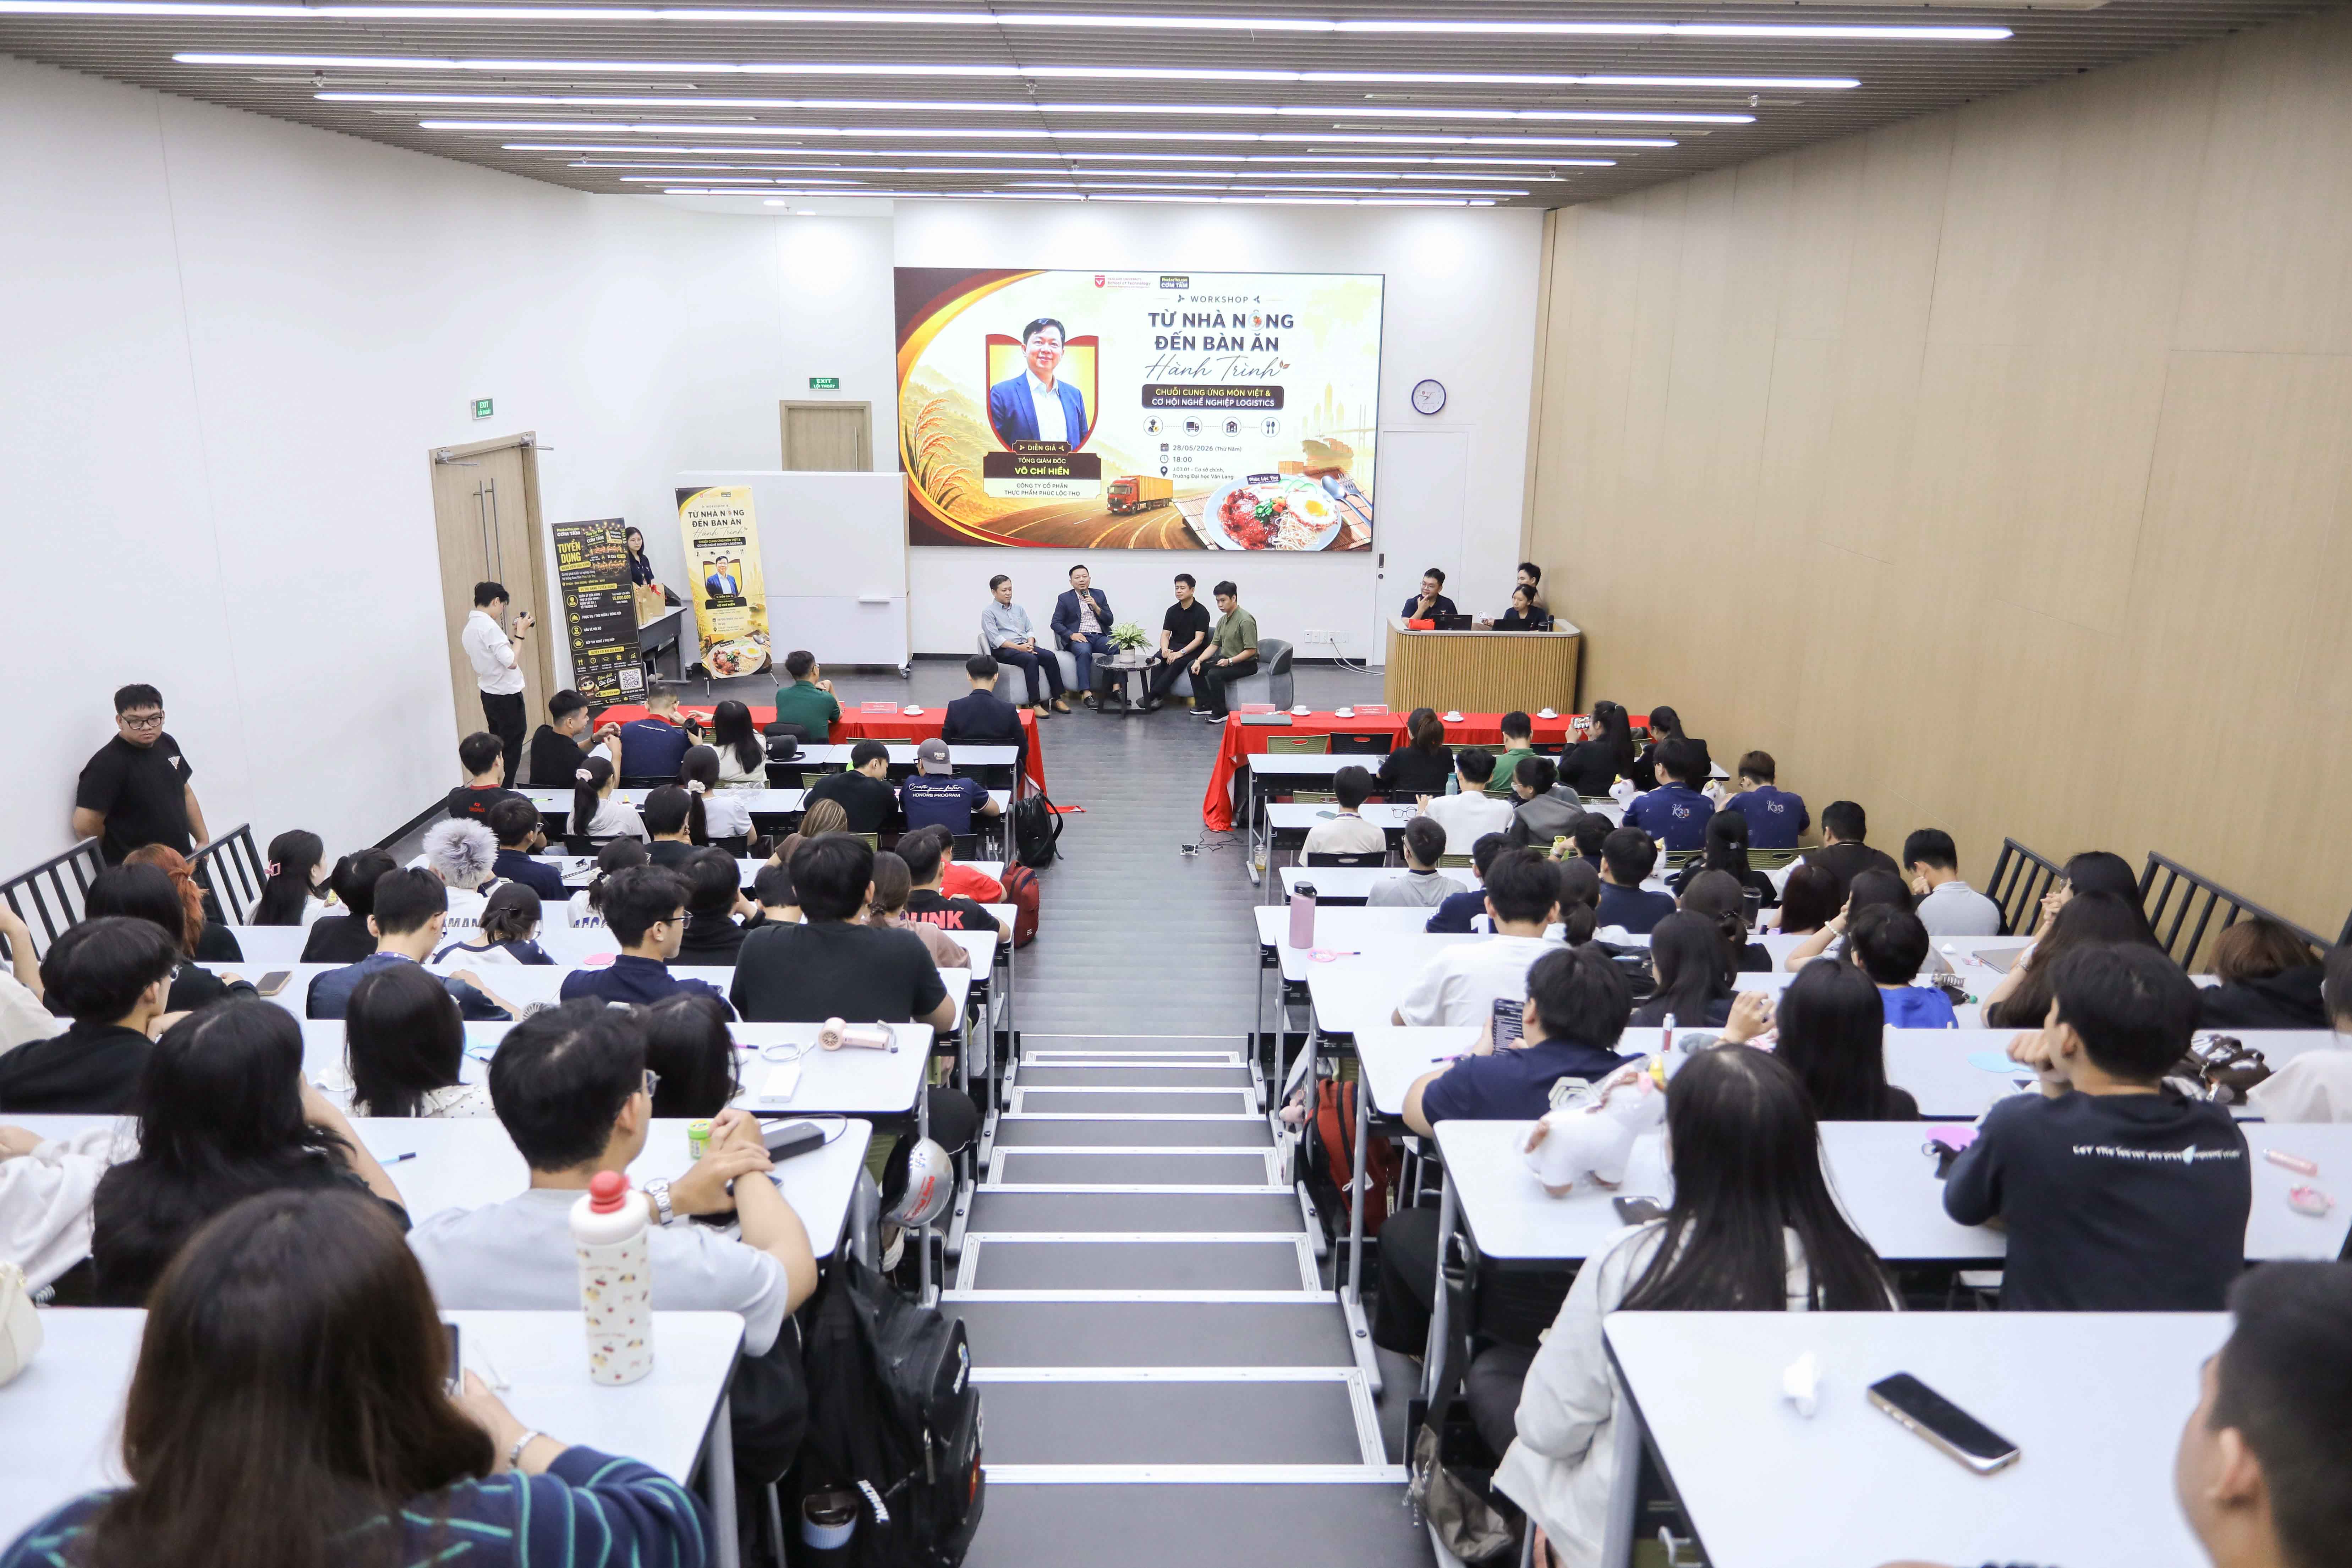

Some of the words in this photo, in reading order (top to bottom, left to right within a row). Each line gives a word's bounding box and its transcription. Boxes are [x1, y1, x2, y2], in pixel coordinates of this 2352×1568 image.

[1148, 309, 1177, 328] TỪ
[1183, 309, 1226, 328] NHÀ
[1155, 331, 1195, 351] ĐẾN
[1203, 333, 1244, 351] BÀN
[1250, 333, 1278, 352] ĂN
[1145, 353, 1212, 381] Hành
[1216, 355, 1280, 381] Trình
[1156, 386, 1180, 396] CHUỖI
[1207, 388, 1224, 396] ỨNG
[1226, 388, 1246, 396] MÓN
[1247, 389, 1263, 398] VIỆT
[1166, 398, 1179, 407] HỘI
[1205, 398, 1234, 408] NGHIỆP
[1014, 466, 1027, 475] VÕ
[688, 510, 698, 518] TỪ
[701, 509, 718, 517] NHÀ
[692, 519, 708, 527] ĐẾN
[711, 517, 728, 526] BÀN
[693, 528, 718, 539] Hành
[720, 526, 744, 537] Trình
[557, 539, 581, 553] TUYỂN
[560, 552, 581, 565] DỤNG
[1672, 804, 1690, 818] K30
